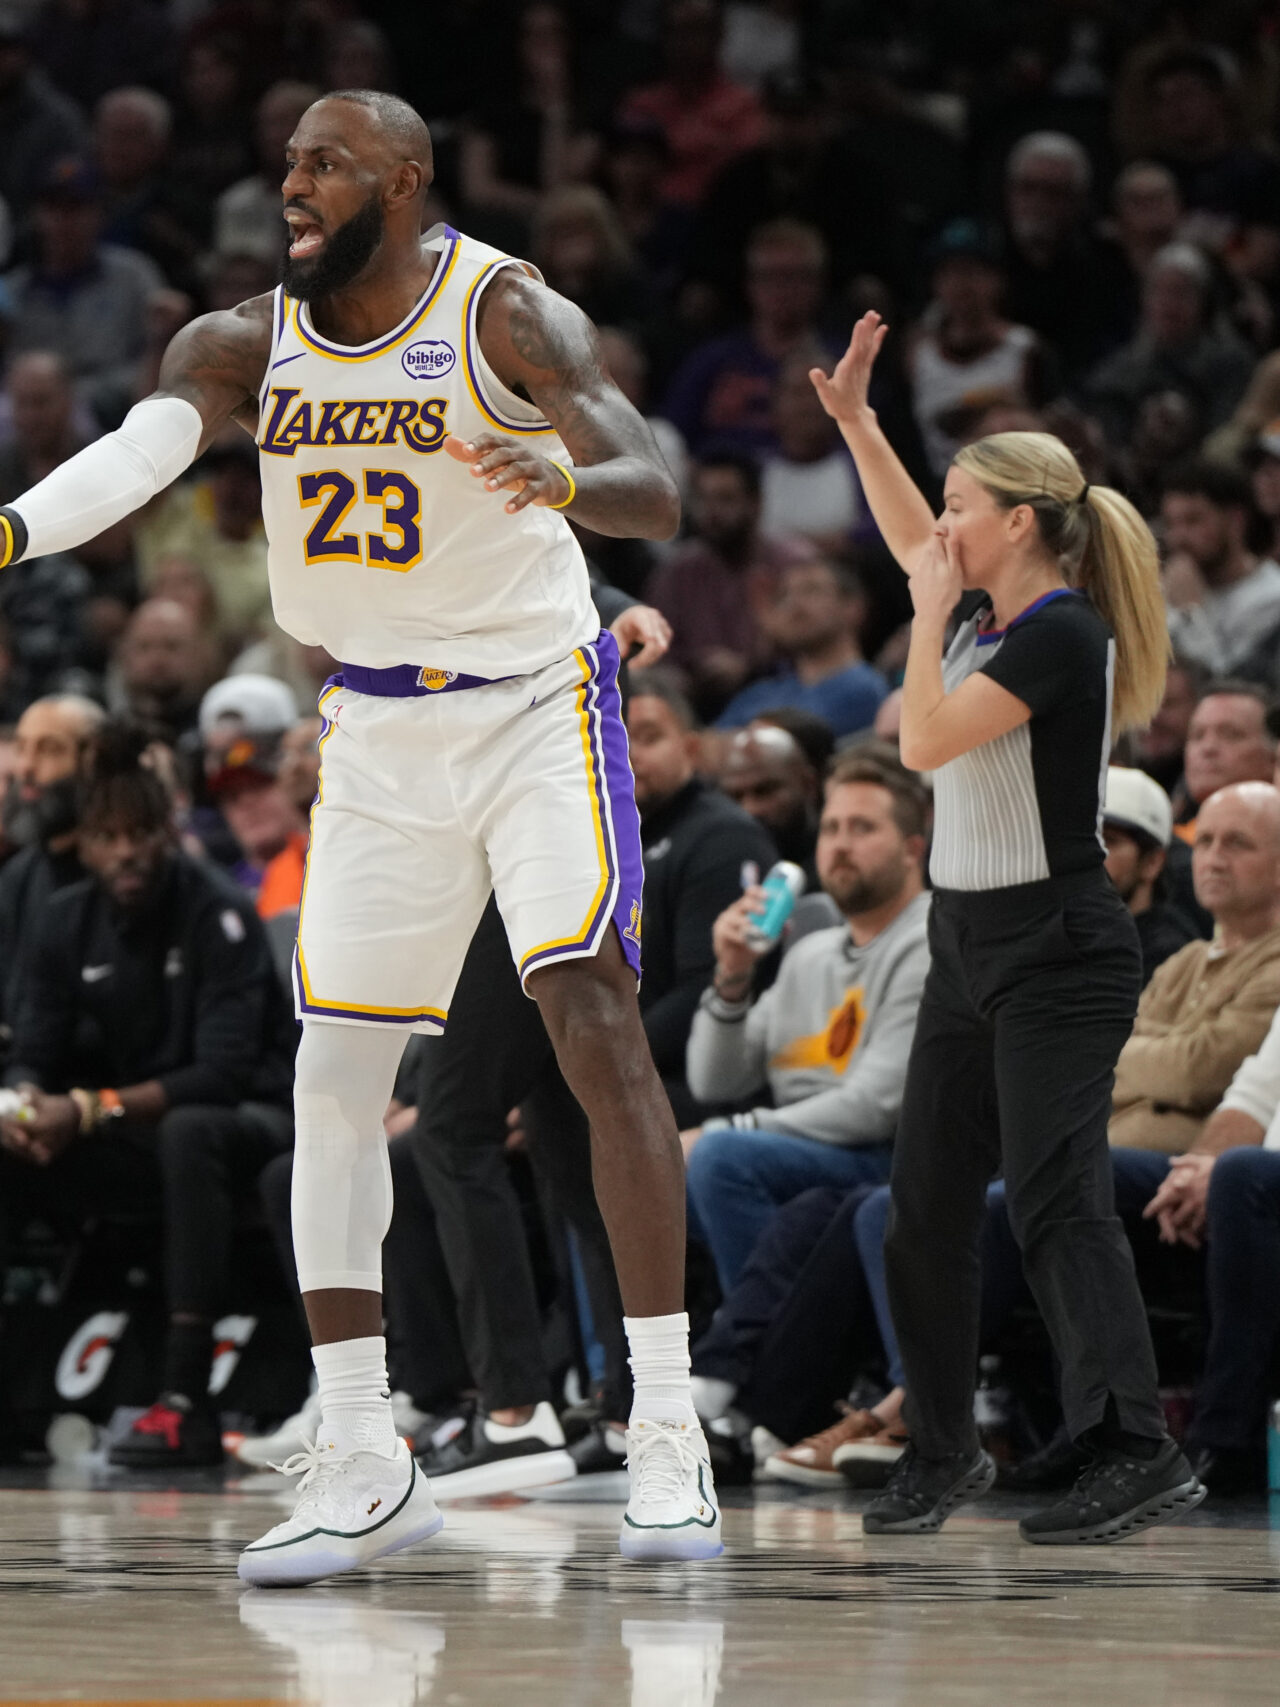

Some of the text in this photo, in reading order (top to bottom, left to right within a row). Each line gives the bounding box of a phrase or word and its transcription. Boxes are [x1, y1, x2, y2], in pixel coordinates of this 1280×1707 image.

[407, 350, 453, 367] bibigo
[260, 387, 451, 458] LAKERS
[297, 468, 423, 573] 23
[56, 1311, 129, 1399] G
